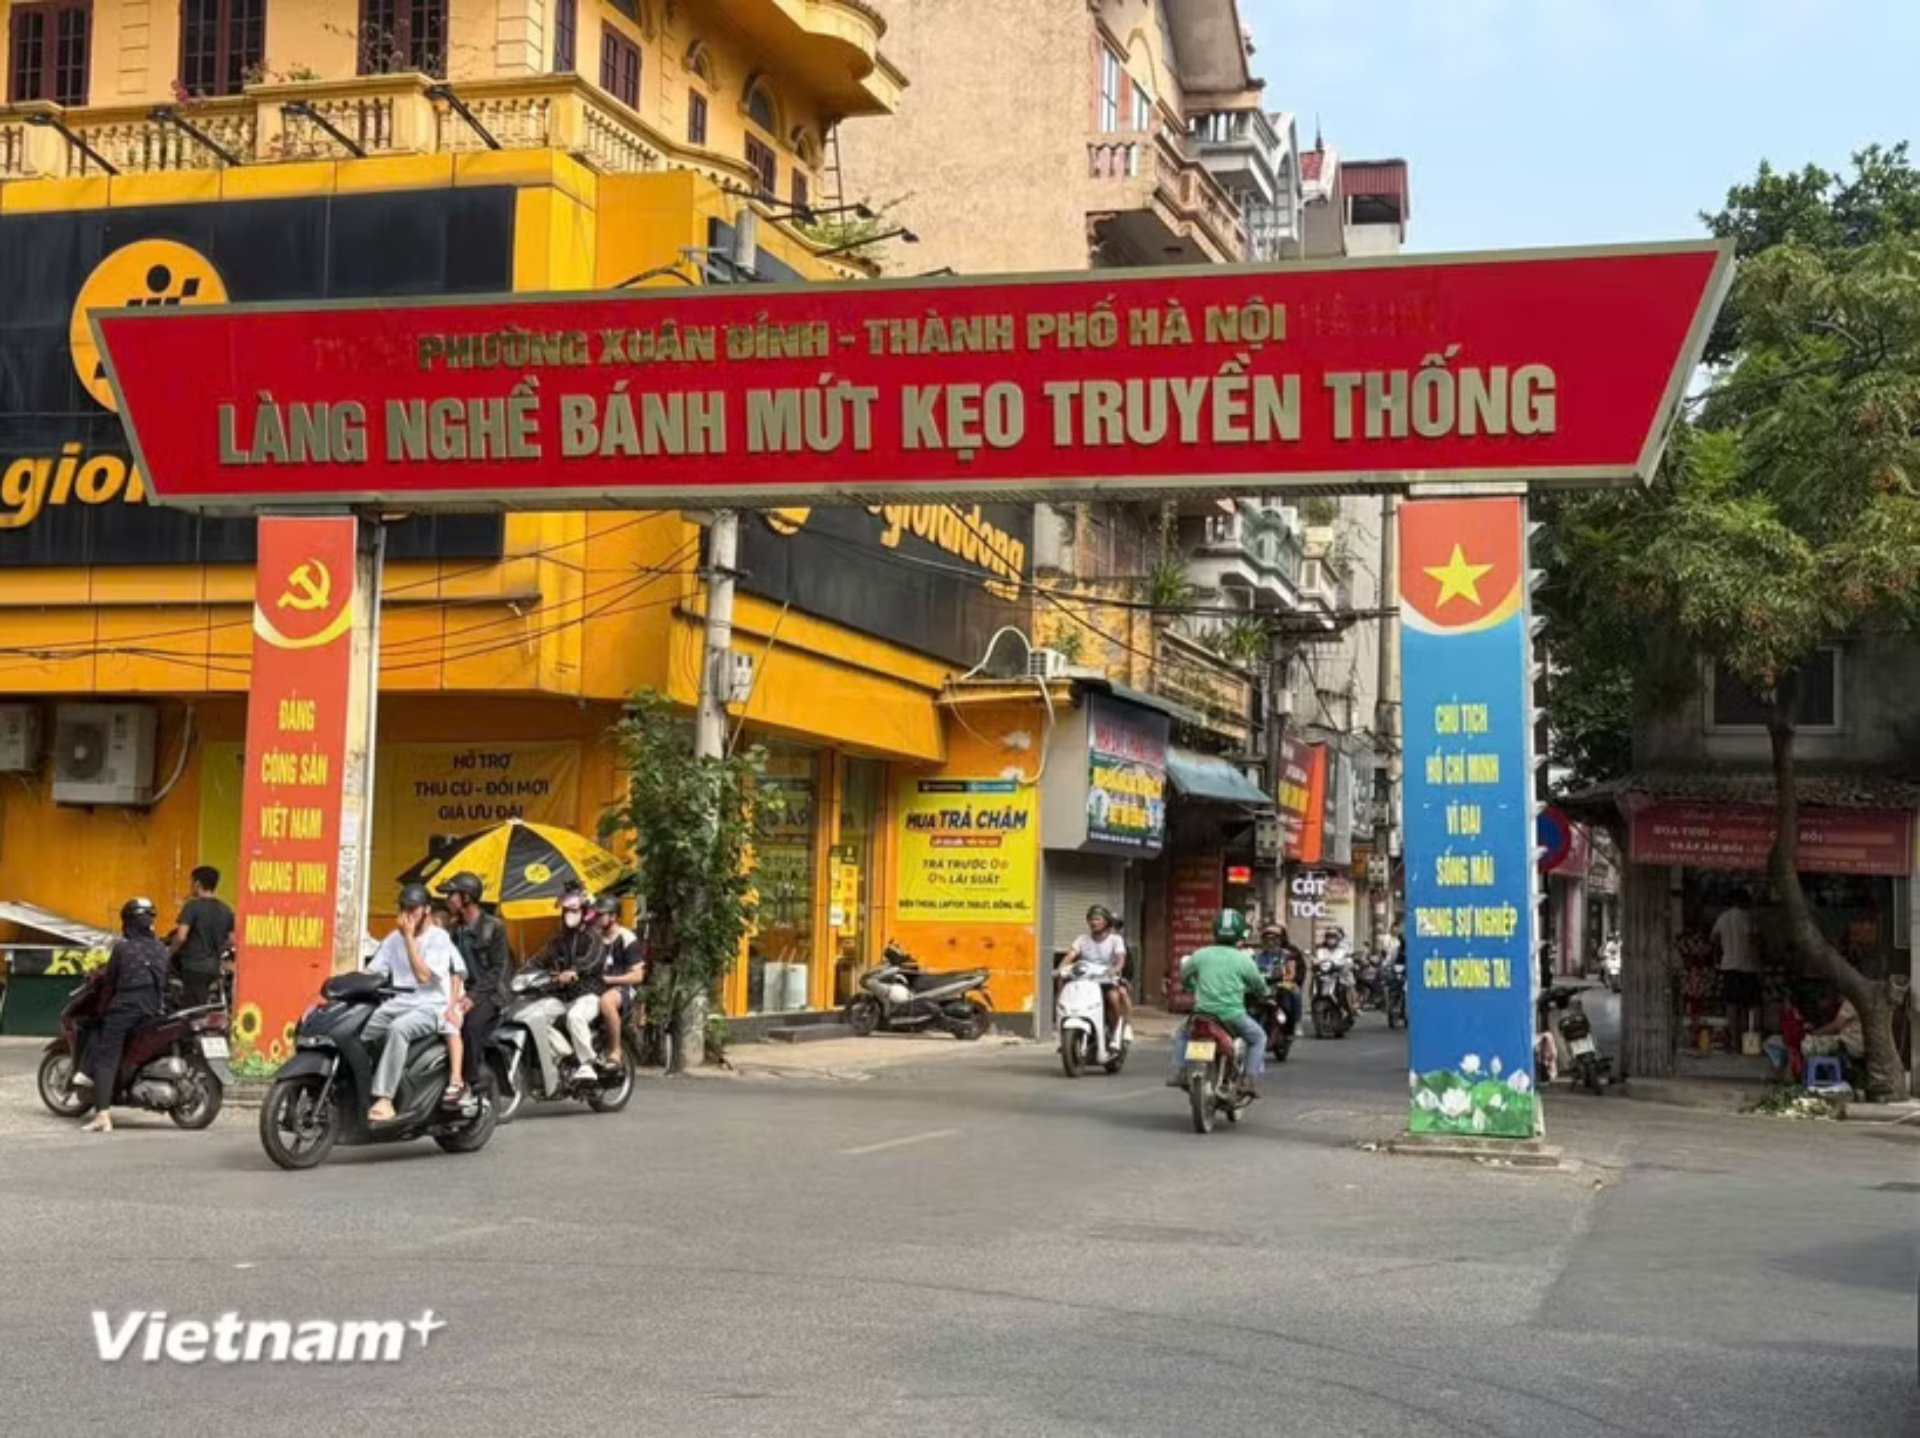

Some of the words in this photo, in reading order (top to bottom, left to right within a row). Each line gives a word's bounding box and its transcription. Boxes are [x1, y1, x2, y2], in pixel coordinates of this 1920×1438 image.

[418, 325, 590, 371] PHƯỜNG
[600, 317, 716, 363] XUÂN
[864, 308, 1013, 356] THÀNH
[1027, 293, 1119, 349] PHỐ
[1129, 298, 1193, 346] HÀ
[1205, 296, 1287, 350] NỘI
[217, 390, 368, 467] LÀNG
[386, 374, 543, 463] NGHỀ
[560, 380, 728, 458] BÁNH
[746, 371, 879, 453] MỨT
[903, 382, 1025, 461] KẸO
[1044, 351, 1301, 448] TRUYỀN
[1323, 343, 1558, 441] THỐNG
[278, 690, 316, 731] ĐẢNG
[261, 747, 297, 791] CỘNG
[299, 743, 329, 787] SẢN
[414, 782, 447, 797] THU
[261, 800, 289, 843] VIỆT
[290, 807, 323, 840] NAM
[906, 813, 936, 830] MUA
[938, 804, 973, 830] TRẢ
[976, 805, 1029, 834] CHẬM
[248, 860, 293, 895] QUANG
[296, 862, 328, 895] VINH
[245, 908, 284, 947] MUÔN
